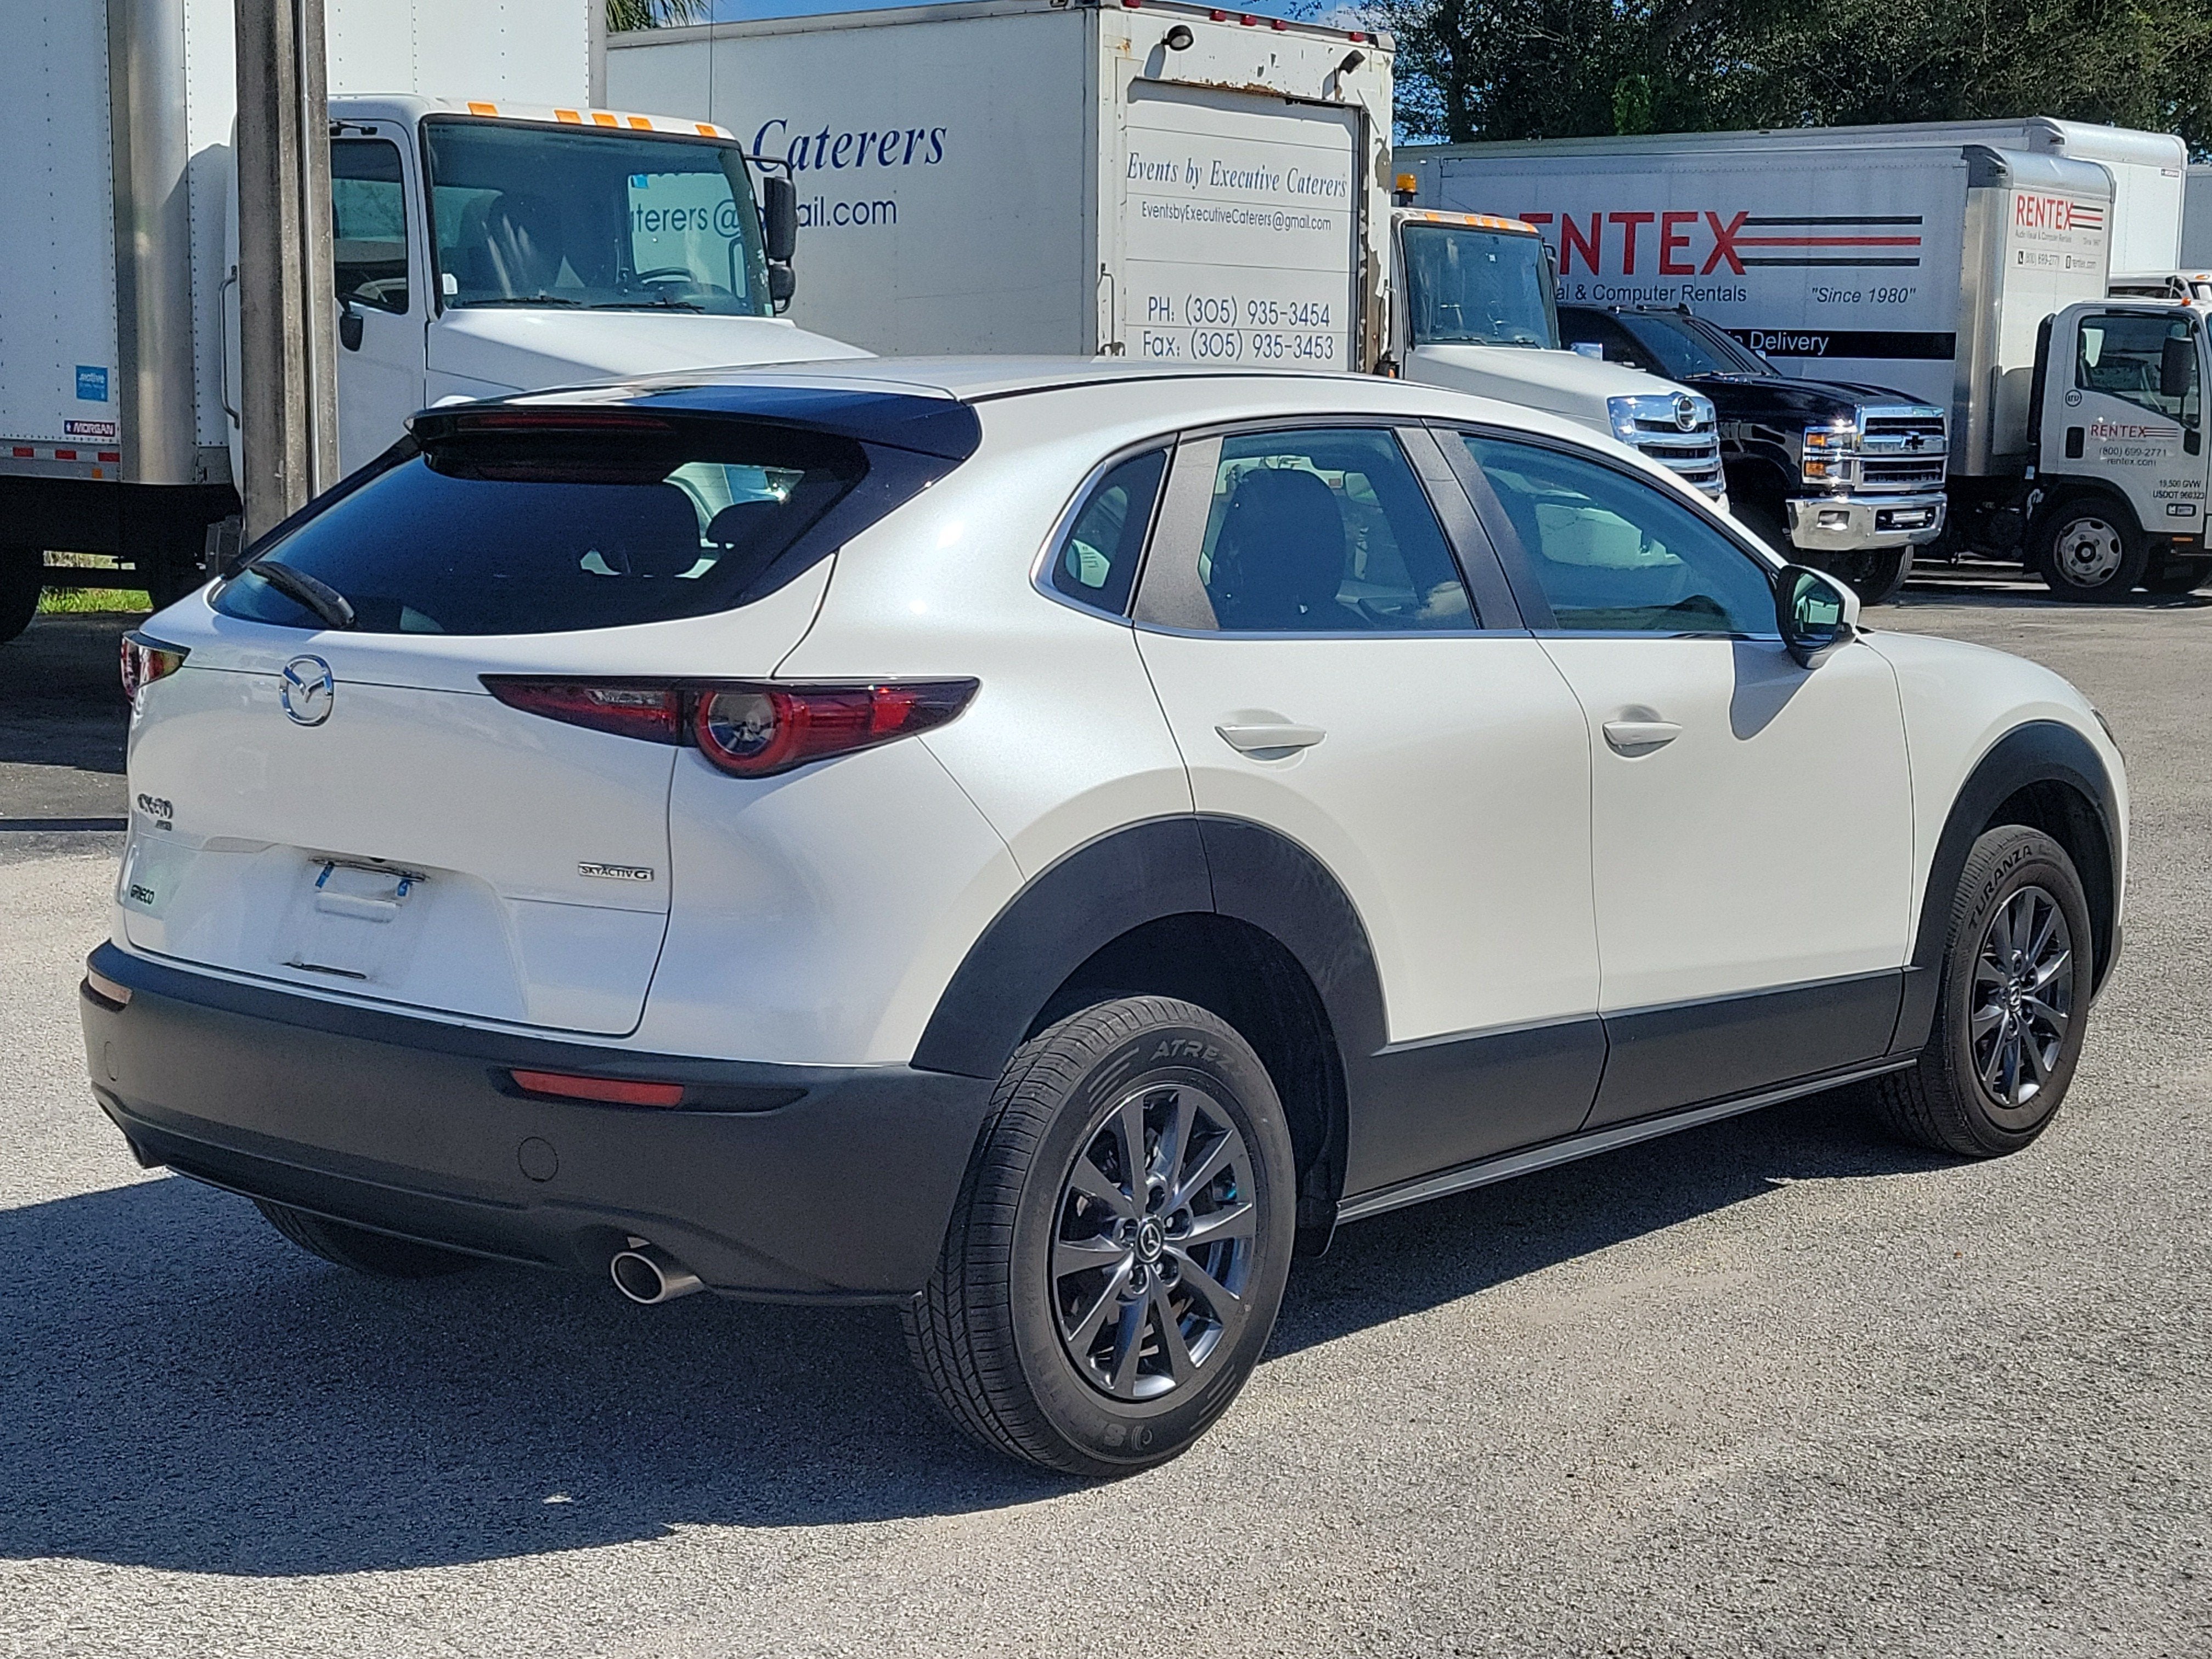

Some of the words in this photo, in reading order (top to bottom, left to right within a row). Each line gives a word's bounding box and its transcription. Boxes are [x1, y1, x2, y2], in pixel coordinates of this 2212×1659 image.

[752, 119, 947, 172] Caterers
[1127, 152, 1178, 182] Events
[1185, 157, 1203, 190] by
[1210, 160, 1279, 191] Executive
[1287, 167, 1347, 198] Caterers
[1142, 201, 1331, 231] EventsbyExecutiveCaterers@gmail.com
[2016, 195, 2073, 232] RENTEX
[1575, 284, 1587, 301] &
[1593, 284, 1676, 304] Computer
[1681, 284, 1747, 302] Rentals
[1812, 287, 1861, 303] "Since
[1869, 287, 1916, 303] 1980"
[1148, 296, 1175, 322] PH:
[1186, 293, 1238, 328] (305)
[1248, 300, 1330, 327] 935-3454
[1143, 330, 1180, 357] Fax:
[1191, 328, 1243, 361] (305)
[1252, 334, 1334, 360] 935-3453
[1750, 331, 1829, 356] Delivery
[73, 422, 113, 435] MORGAN
[2091, 424, 2146, 438] RENTEX
[2100, 445, 2122, 457] (800)
[2153, 490, 2179, 499] USDOT
[1968, 845, 2033, 930] TURANZA
